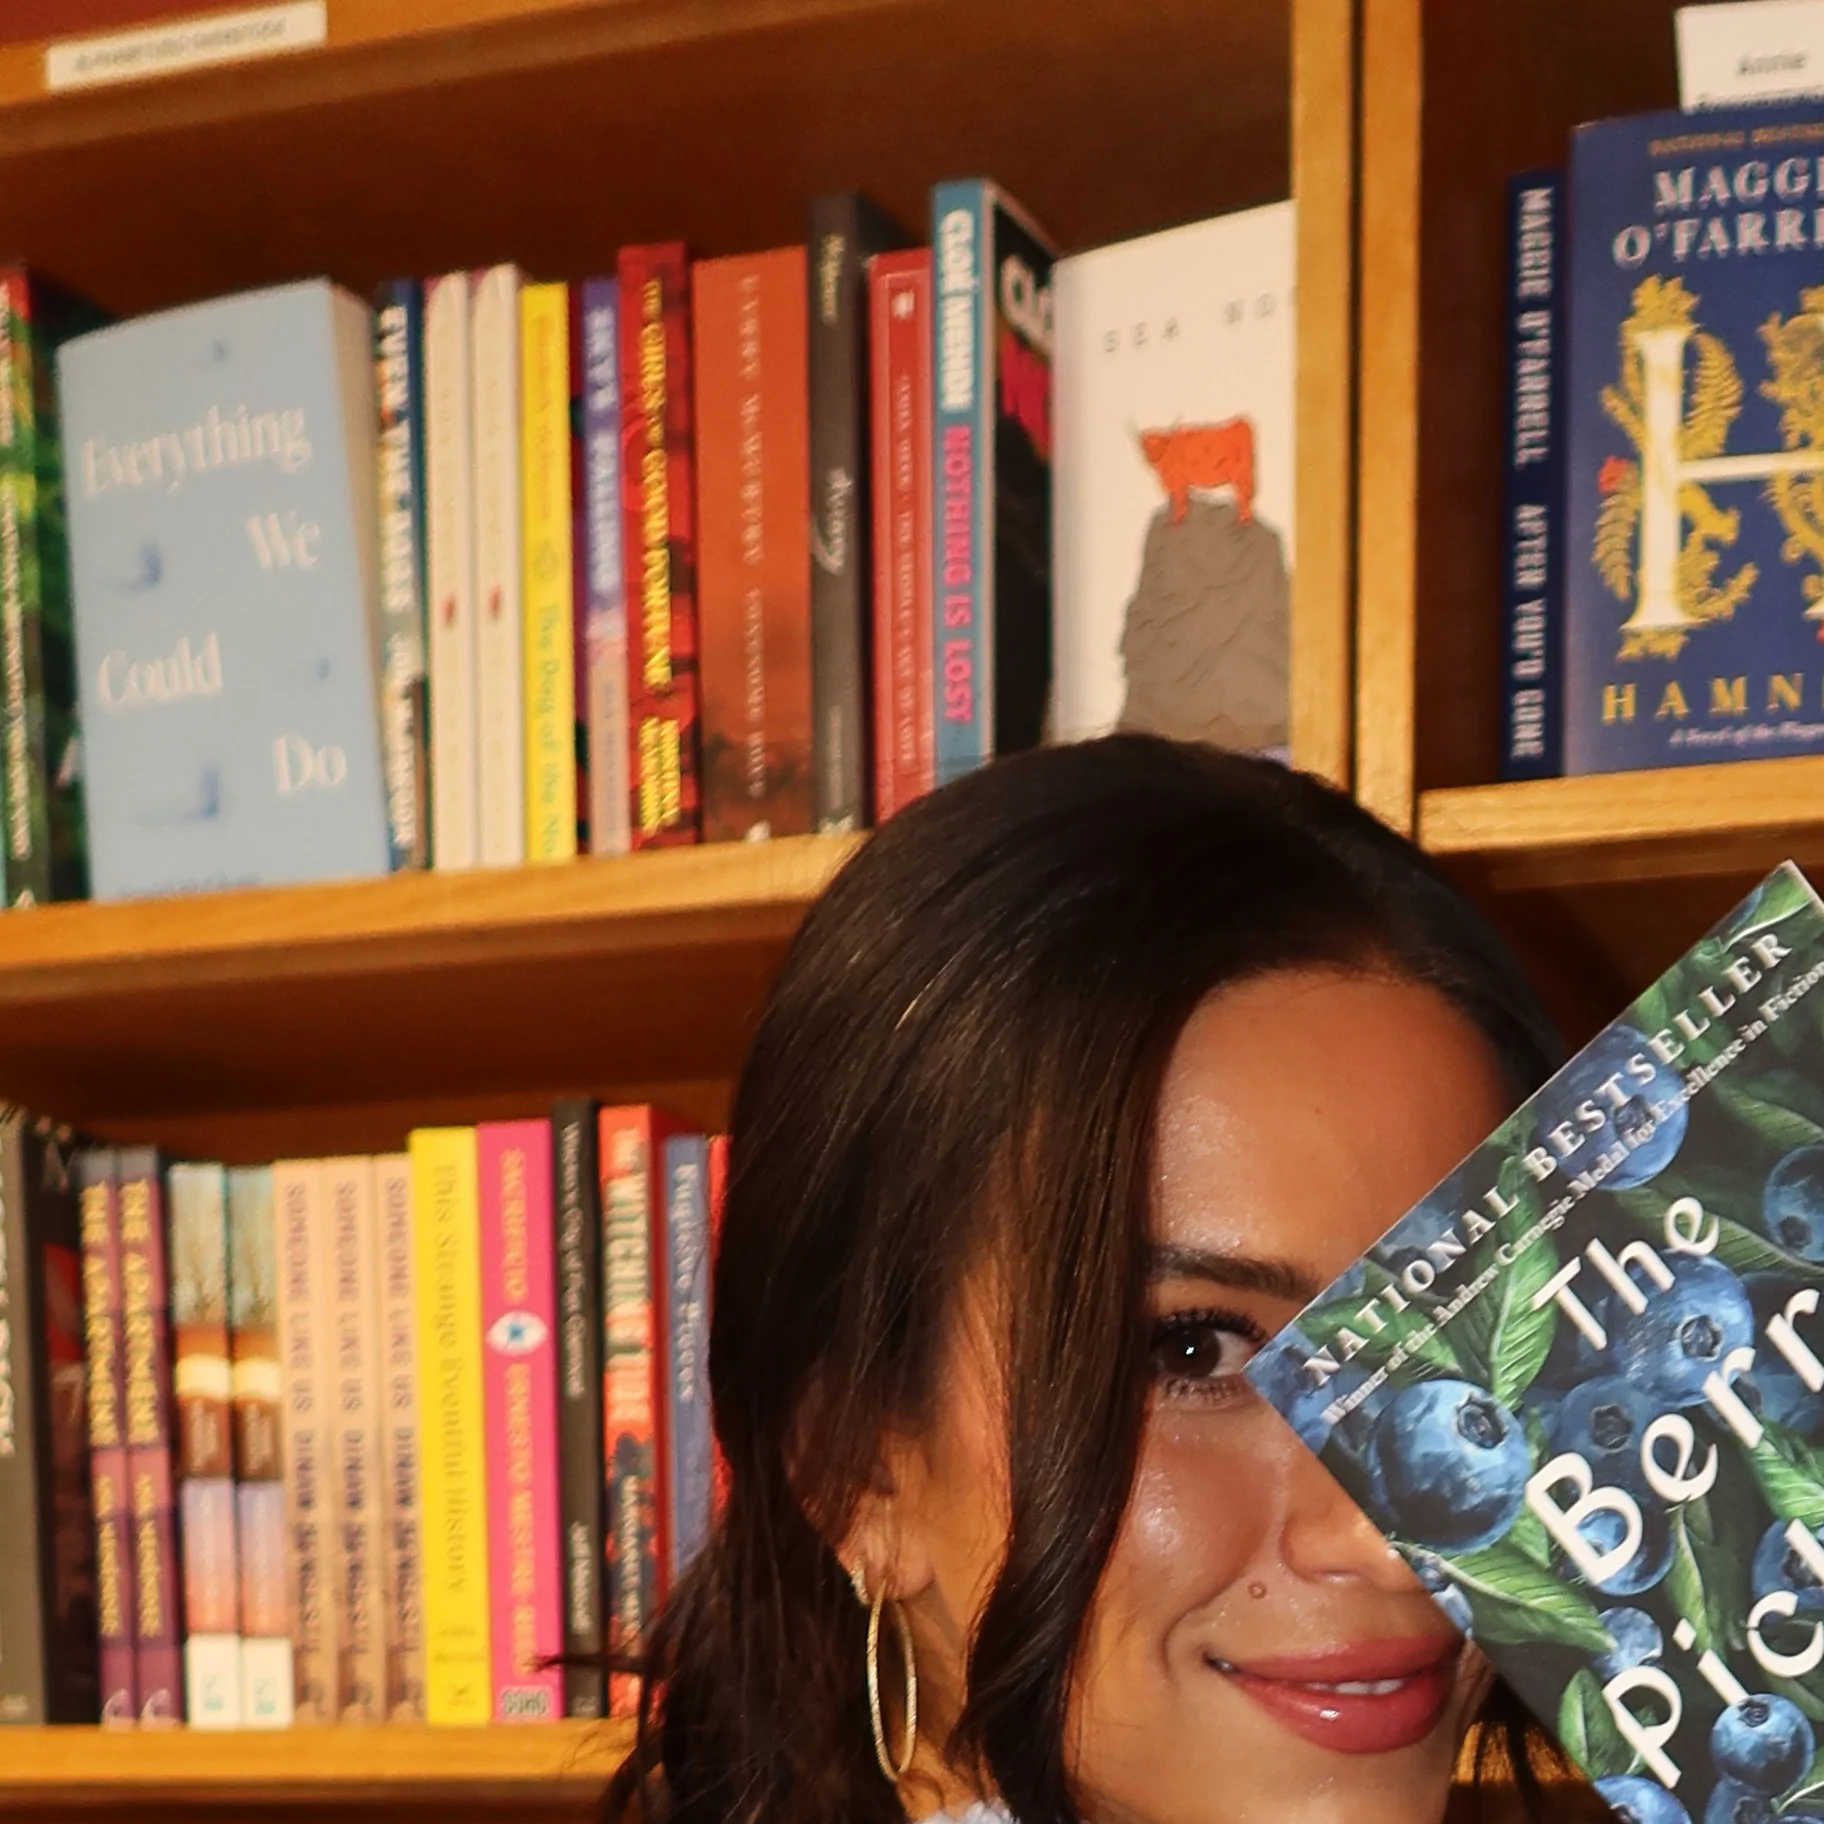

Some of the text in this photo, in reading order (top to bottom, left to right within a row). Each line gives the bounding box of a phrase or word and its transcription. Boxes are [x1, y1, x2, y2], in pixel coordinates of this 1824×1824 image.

[940, 295, 974, 410] MEHDI
[82, 403, 311, 500] Everything
[943, 424, 973, 584] NOTHING
[1511, 187, 1554, 762] MAGGIE O'FARRELL AFTER YOU'D GONE
[246, 510, 322, 571] We
[943, 596, 971, 627] IS
[98, 632, 224, 712] Could
[942, 637, 972, 724] LOST
[273, 731, 349, 797] Do
[1303, 933, 1792, 1387] NATIONAL BESTSELLER
[1320, 1364, 1389, 1426] Winner
[1386, 1349, 1411, 1376] of
[1405, 1320, 1438, 1356] the
[1431, 1266, 1500, 1331] Andrew
[1494, 1190, 1576, 1268] Carnegie
[1565, 1137, 1631, 1202] Medal
[1625, 1115, 1658, 1153] for
[1651, 1037, 1748, 1124] Excellence
[1741, 1019, 1768, 1046] in
[1530, 1196, 1719, 1351] The
[431, 1163, 477, 1596] This Strange Eventful History
